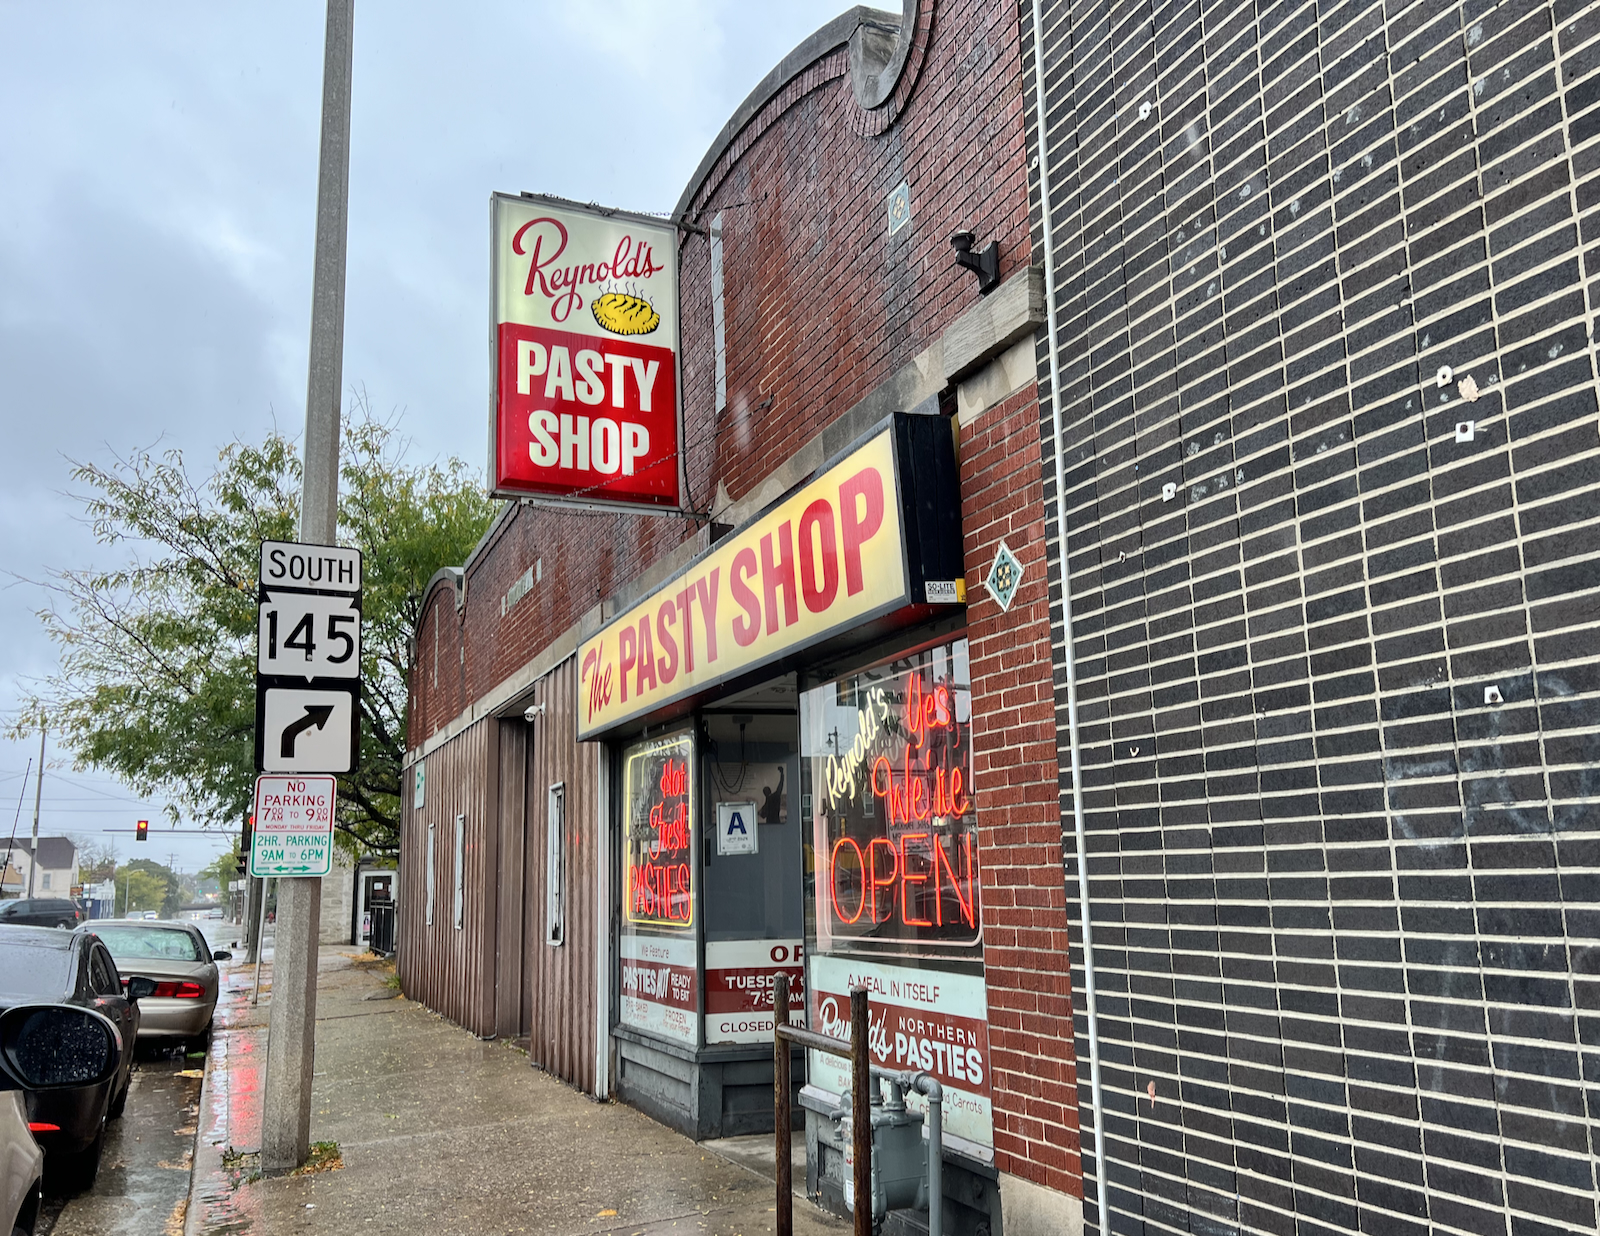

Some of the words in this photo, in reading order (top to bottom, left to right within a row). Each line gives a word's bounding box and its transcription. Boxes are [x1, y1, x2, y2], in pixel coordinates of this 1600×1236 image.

[512, 217, 664, 322] Reynold's
[517, 339, 660, 412] PASTY
[528, 410, 650, 477] SHOP
[268, 549, 354, 584] SOUTH
[581, 639, 614, 725] The
[619, 566, 720, 704] PASTY
[729, 467, 885, 647] SHOP
[266, 610, 355, 664] 145
[906, 672, 952, 749] Yes
[826, 686, 888, 811] Reynold's
[287, 781, 306, 793] NO
[660, 758, 686, 799] Hot
[872, 743, 969, 825] We're
[264, 795, 325, 807] PARKING
[289, 811, 299, 819] TO
[648, 801, 688, 860] Fresh
[727, 812, 747, 835] A
[257, 835, 281, 847] 2HR.
[286, 835, 327, 847] PARKING
[261, 849, 284, 861] 9AM
[300, 848, 323, 861] 6PM
[629, 862, 691, 921] PASTIES
[830, 832, 975, 929] OPEN
[623, 965, 657, 996] PASTIES
[656, 967, 671, 1000] HOT
[670, 973, 691, 989] READY
[672, 988, 680, 1000] TO
[680, 990, 690, 1002] EAT
[725, 974, 796, 989] TUESDY
[750, 990, 775, 1005] 7:3
[788, 992, 804, 1003] AM
[847, 973, 855, 989] A
[890, 980, 900, 998] IN
[903, 982, 940, 1004] ITSELF
[665, 1009, 687, 1024] FROZEN
[720, 1020, 774, 1033] CLOSED
[899, 1016, 977, 1047] NORTHERN
[895, 1032, 983, 1085] PASTIES
[953, 1092, 983, 1115] Carrots
